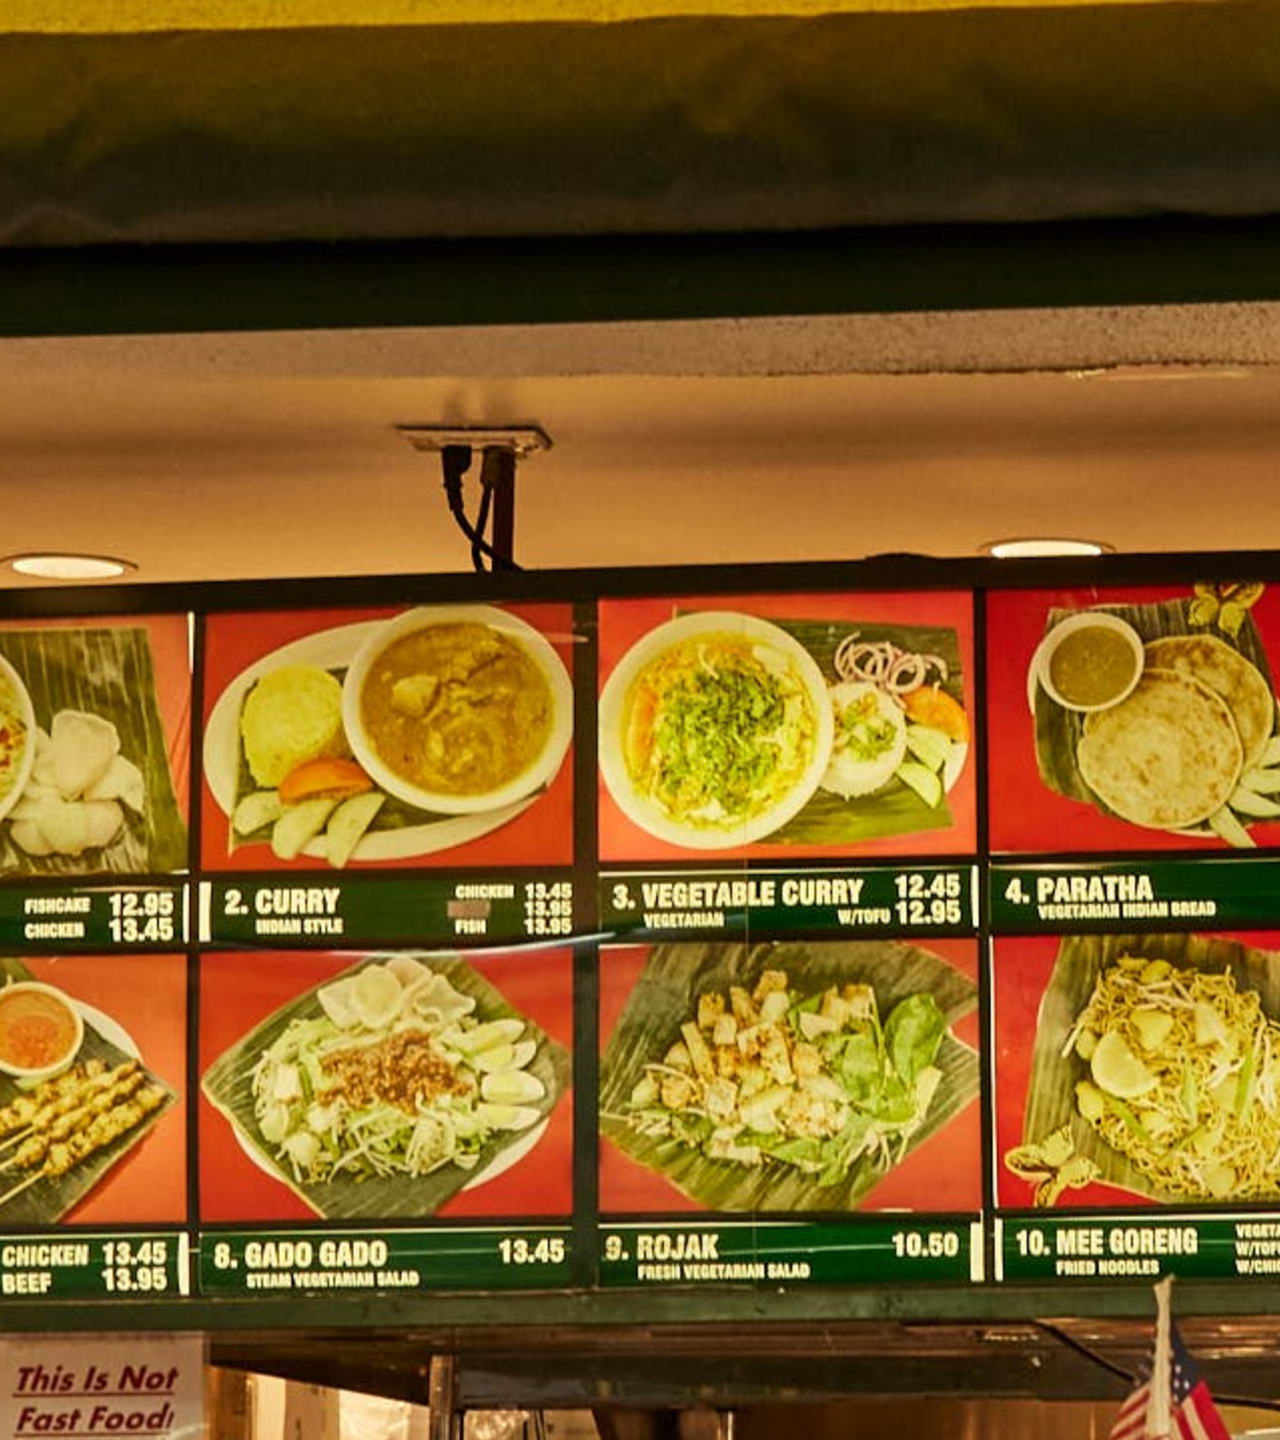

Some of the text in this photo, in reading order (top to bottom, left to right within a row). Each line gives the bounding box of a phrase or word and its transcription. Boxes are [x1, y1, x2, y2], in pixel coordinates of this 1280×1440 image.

[455, 884, 572, 899] CHICKEN 13.45
[612, 878, 864, 909] 3. VEGETABLE CURRY
[894, 875, 960, 899] 12.45
[1005, 875, 1153, 904] 4. PARATHA
[24, 892, 173, 917] FISHCAKE 12.95
[224, 888, 340, 915] 2. CURRY
[524, 901, 572, 916] 13.95
[838, 900, 960, 925] W/TOFU 12.95
[1037, 901, 1217, 920] VEGETARIAN INDIAN BREAD
[24, 918, 173, 942] CHICKEN 13.45
[255, 918, 342, 934] INDIAN STYLE
[455, 919, 572, 934] FISH 13.95
[643, 912, 725, 928] VEGETARIAN
[1, 1241, 167, 1267] CHICKEN 13.45
[214, 1240, 388, 1268] 8. GADO GADO
[498, 1238, 565, 1263] 13.45
[605, 1234, 719, 1260] 9. ROJAK
[892, 1232, 959, 1257] 10.50
[1016, 1228, 1197, 1255] 10. MEE GORENG
[1056, 1259, 1160, 1275] FRIED NOODLES
[1, 1267, 167, 1294] BEEF 13.95
[17, 1365, 179, 1391] This Is Not
[17, 1403, 174, 1432] Fast Food!
